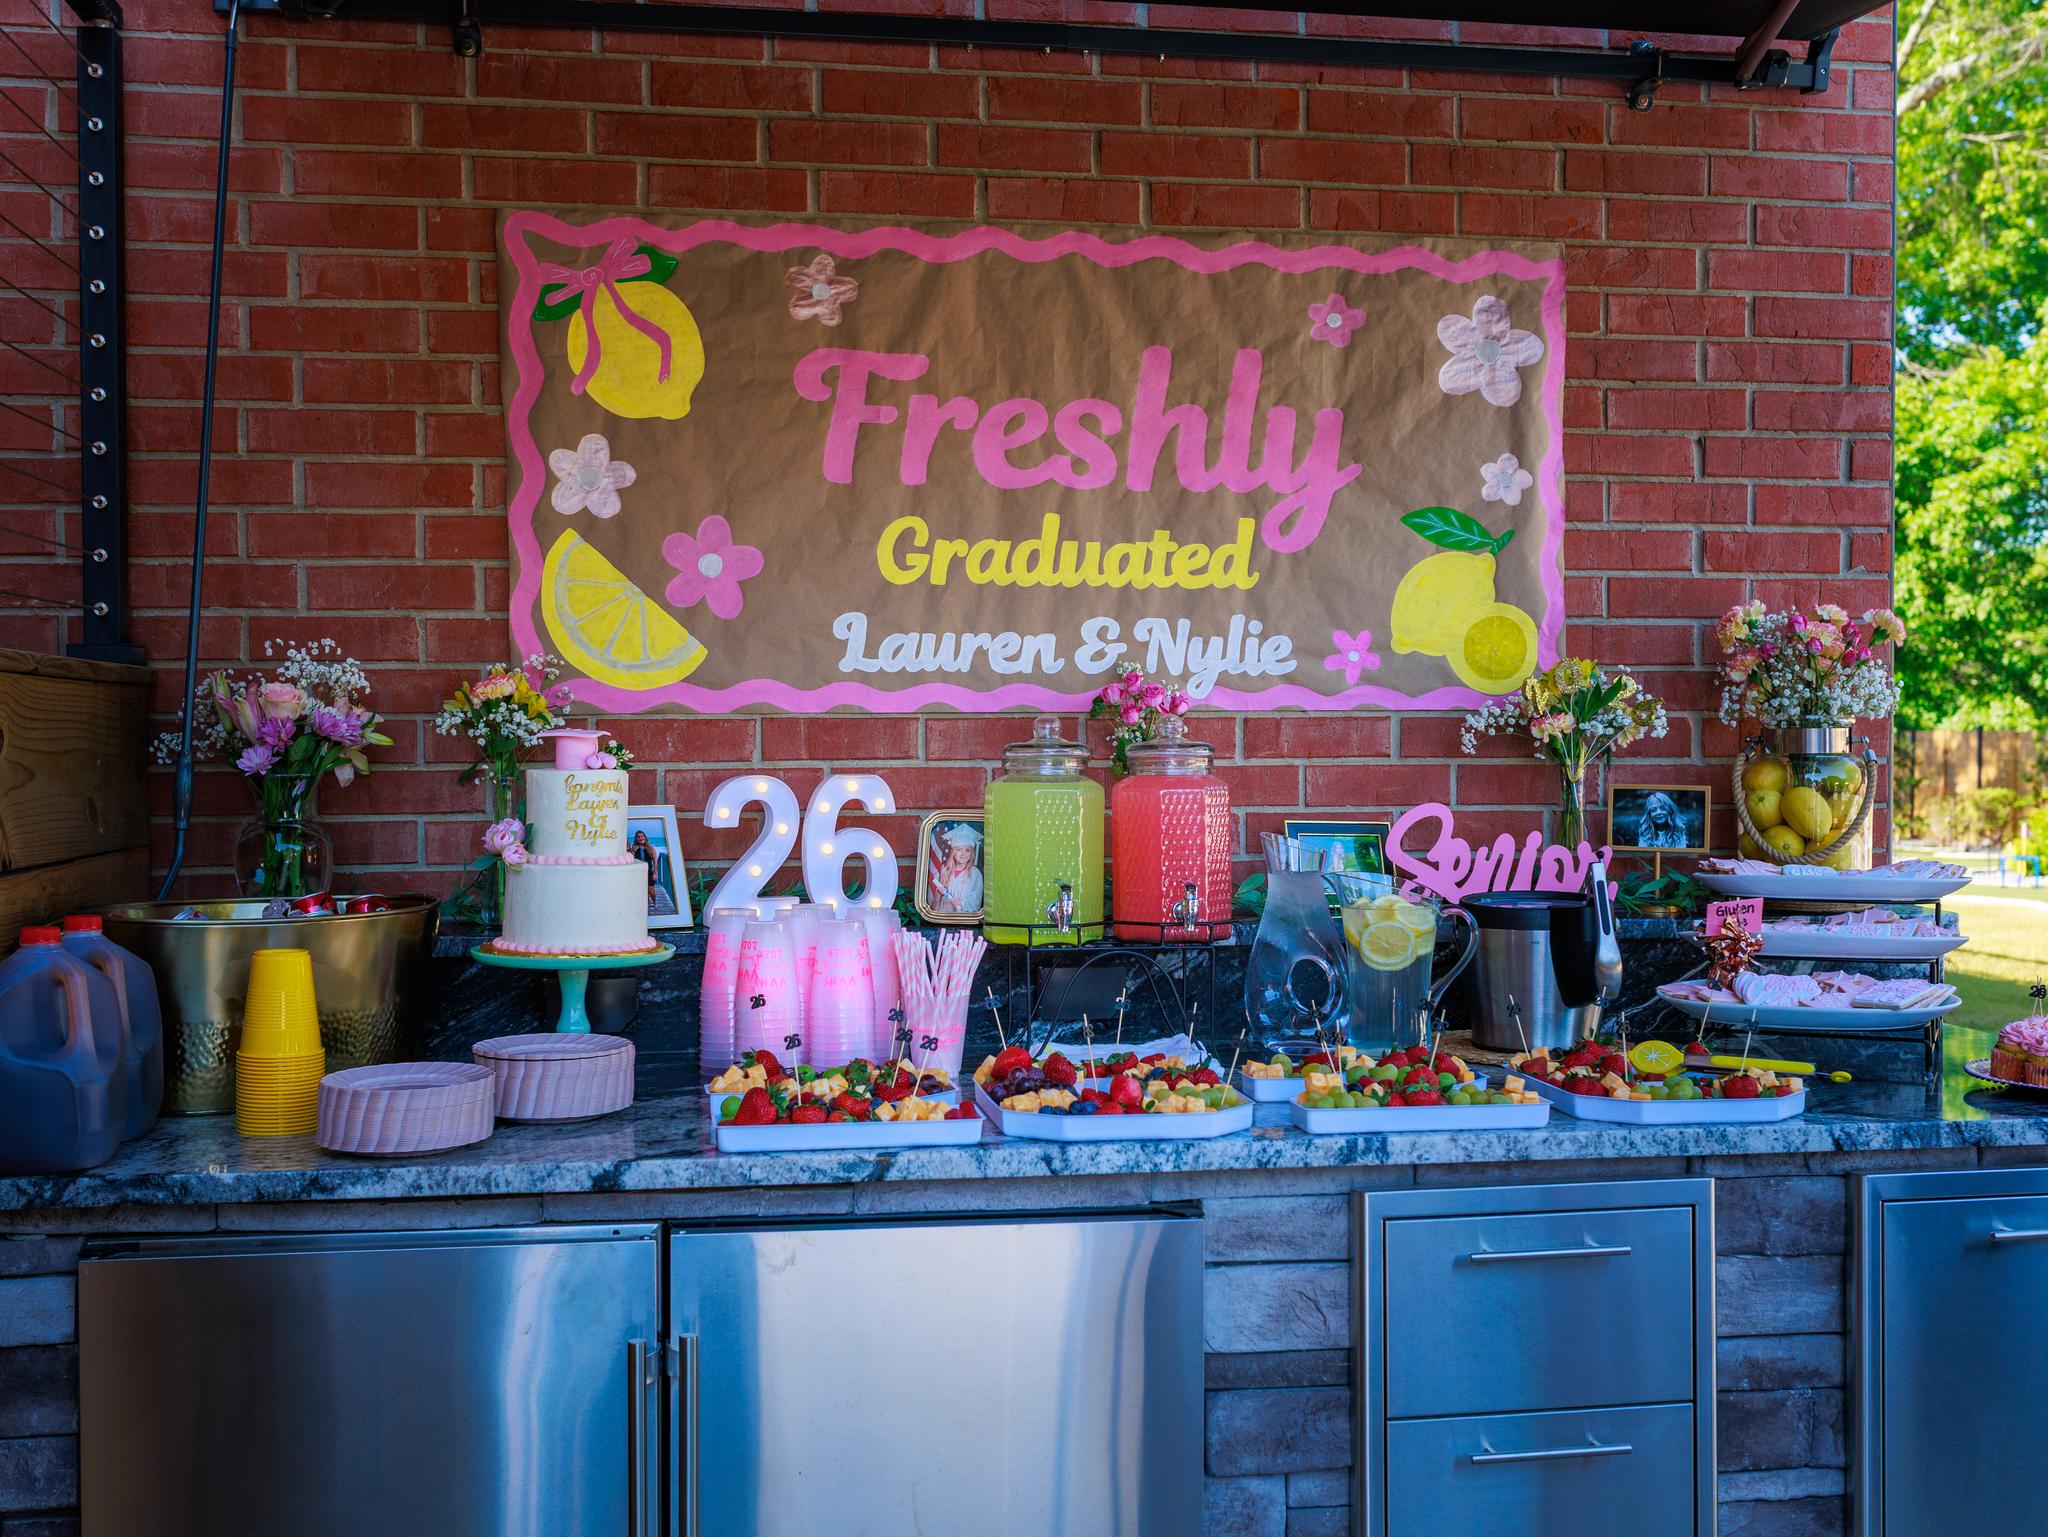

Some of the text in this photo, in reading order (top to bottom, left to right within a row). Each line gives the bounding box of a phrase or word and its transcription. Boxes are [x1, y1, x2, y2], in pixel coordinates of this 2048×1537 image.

[793, 345, 1363, 553] Freshly
[876, 512, 1260, 590] Graduated
[832, 611, 1297, 699] Lauren & Nylie
[703, 774, 899, 926] 26
[1716, 904, 1755, 917] Gluten
[920, 1035, 939, 1051] 26
